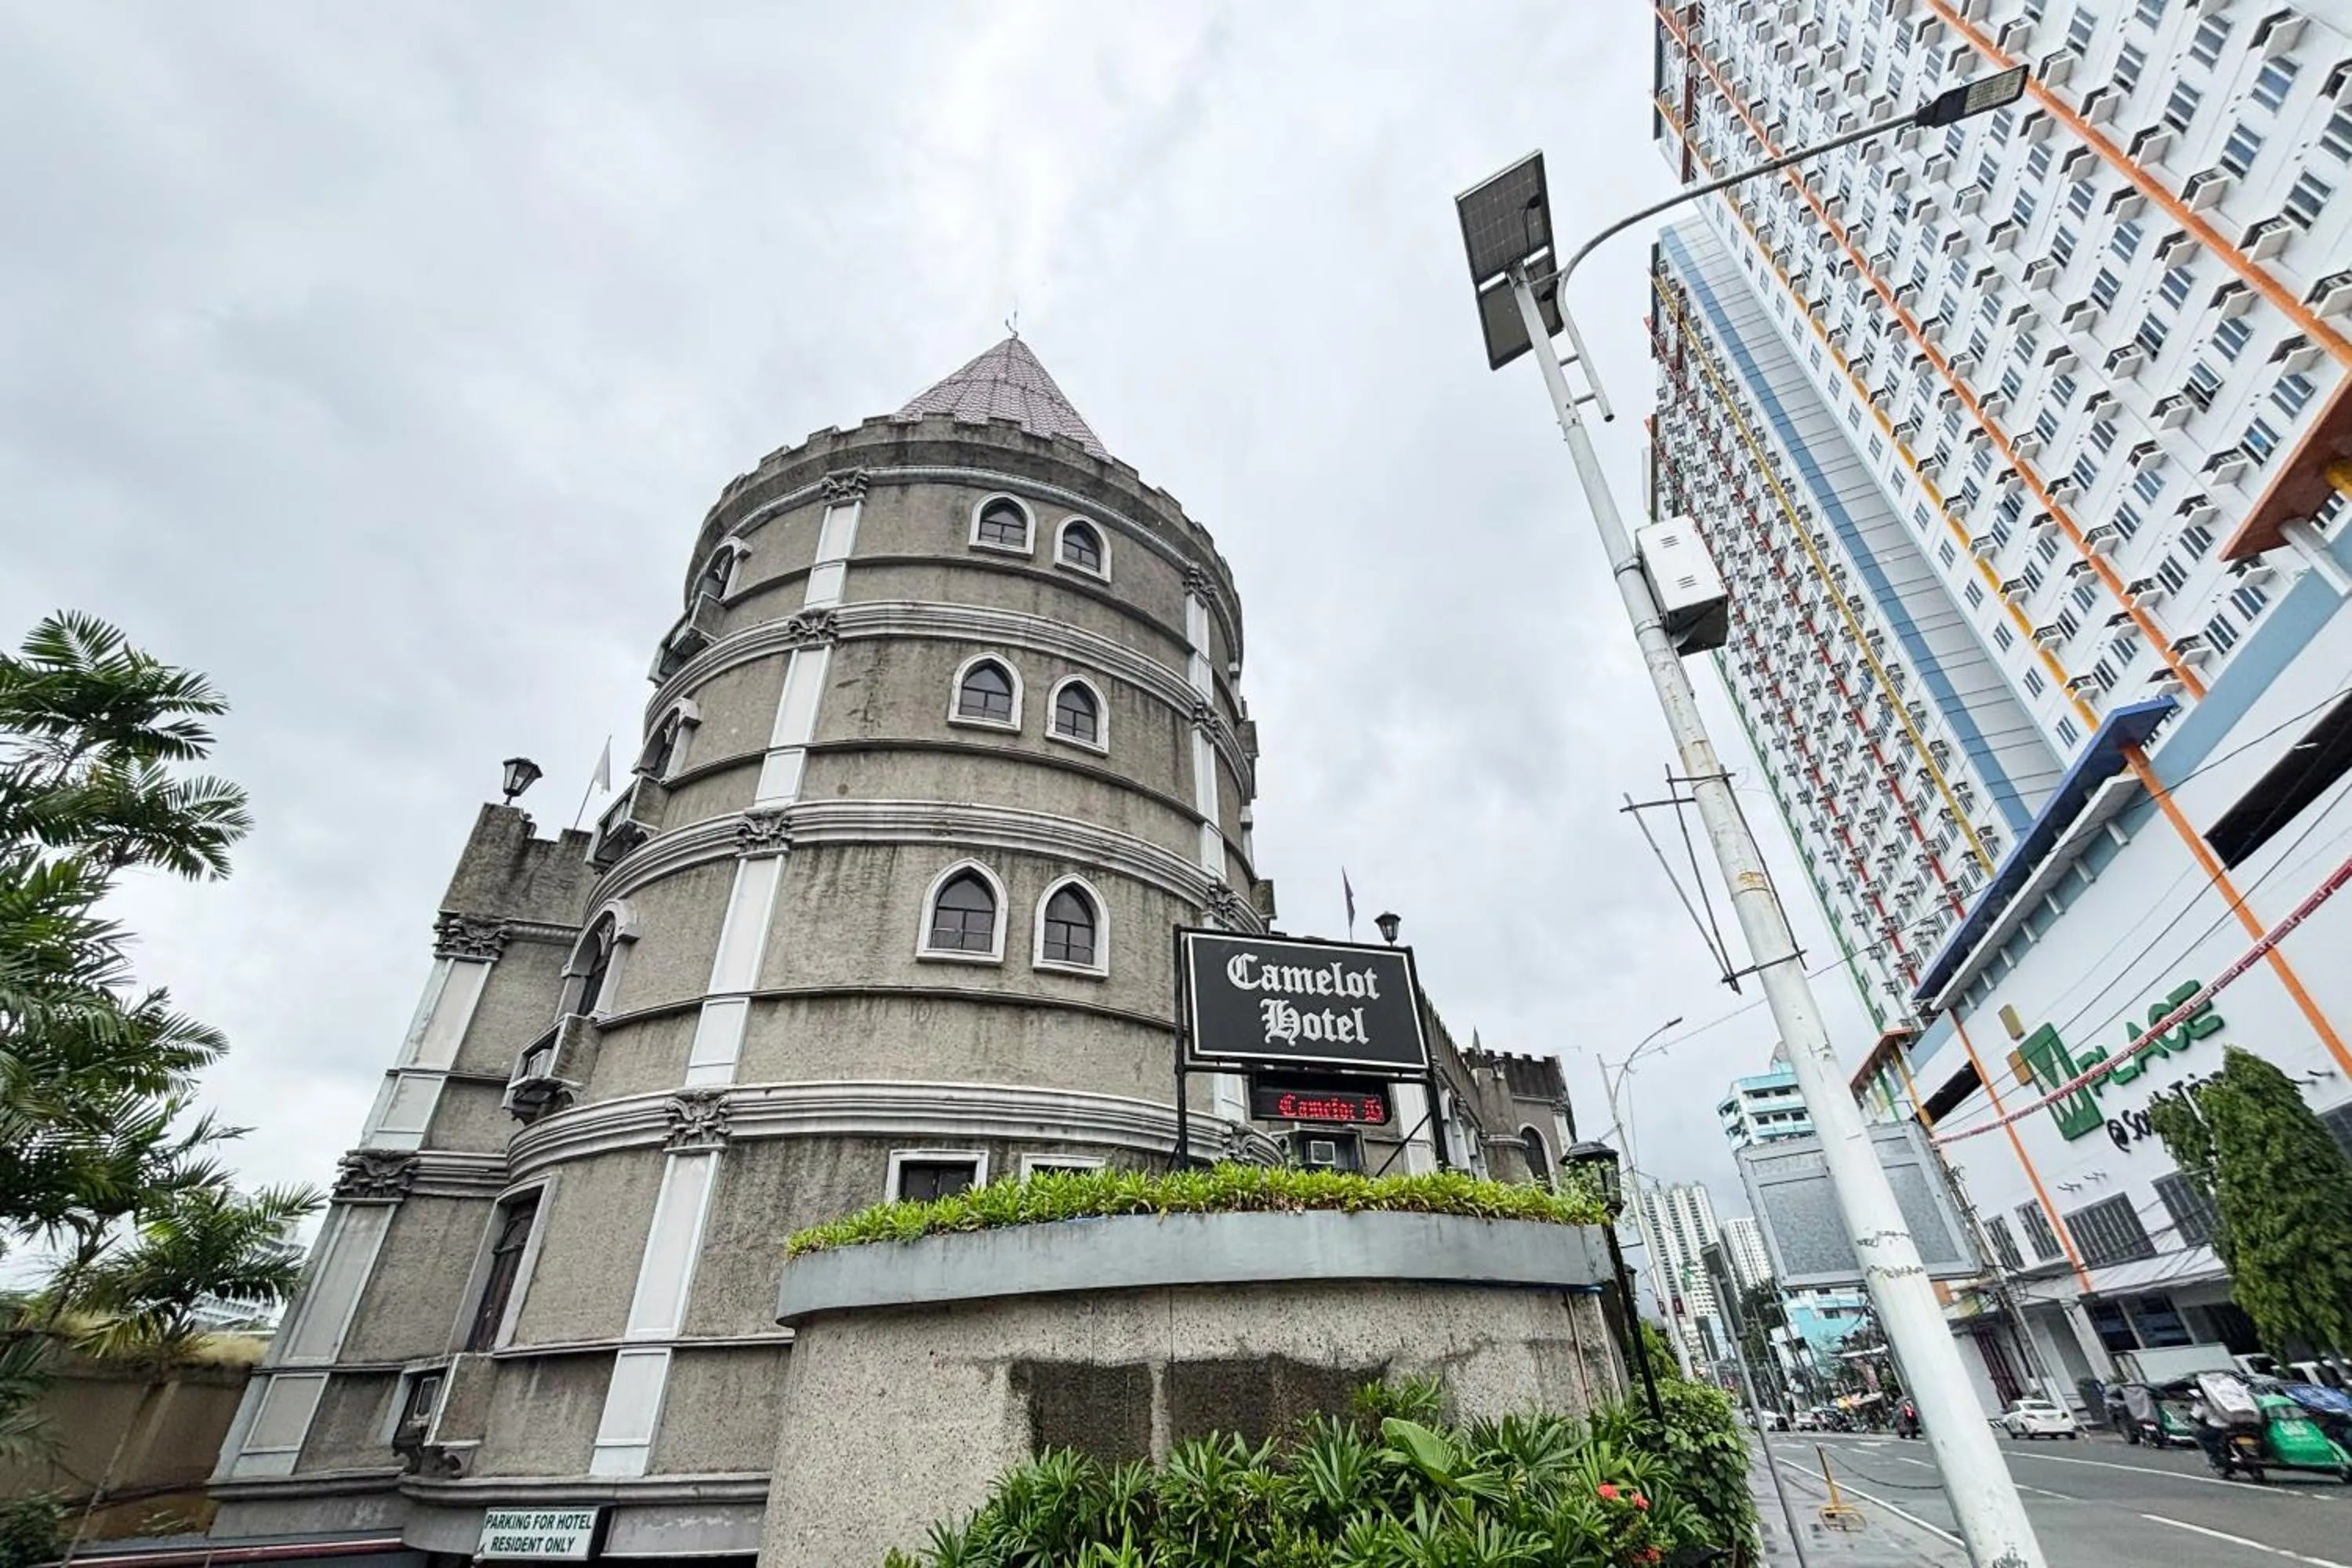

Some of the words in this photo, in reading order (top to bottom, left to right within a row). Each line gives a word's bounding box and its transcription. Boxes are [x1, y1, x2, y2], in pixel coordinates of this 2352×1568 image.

[1227, 953, 1380, 1000] Camelot
[1260, 999, 1370, 1046] Hotel
[485, 1514, 532, 1530] PARKING
[532, 1515, 554, 1530] FOR
[556, 1514, 592, 1530] HOTEL
[490, 1536, 543, 1552] RESIDENT
[544, 1537, 576, 1553] ONLY
